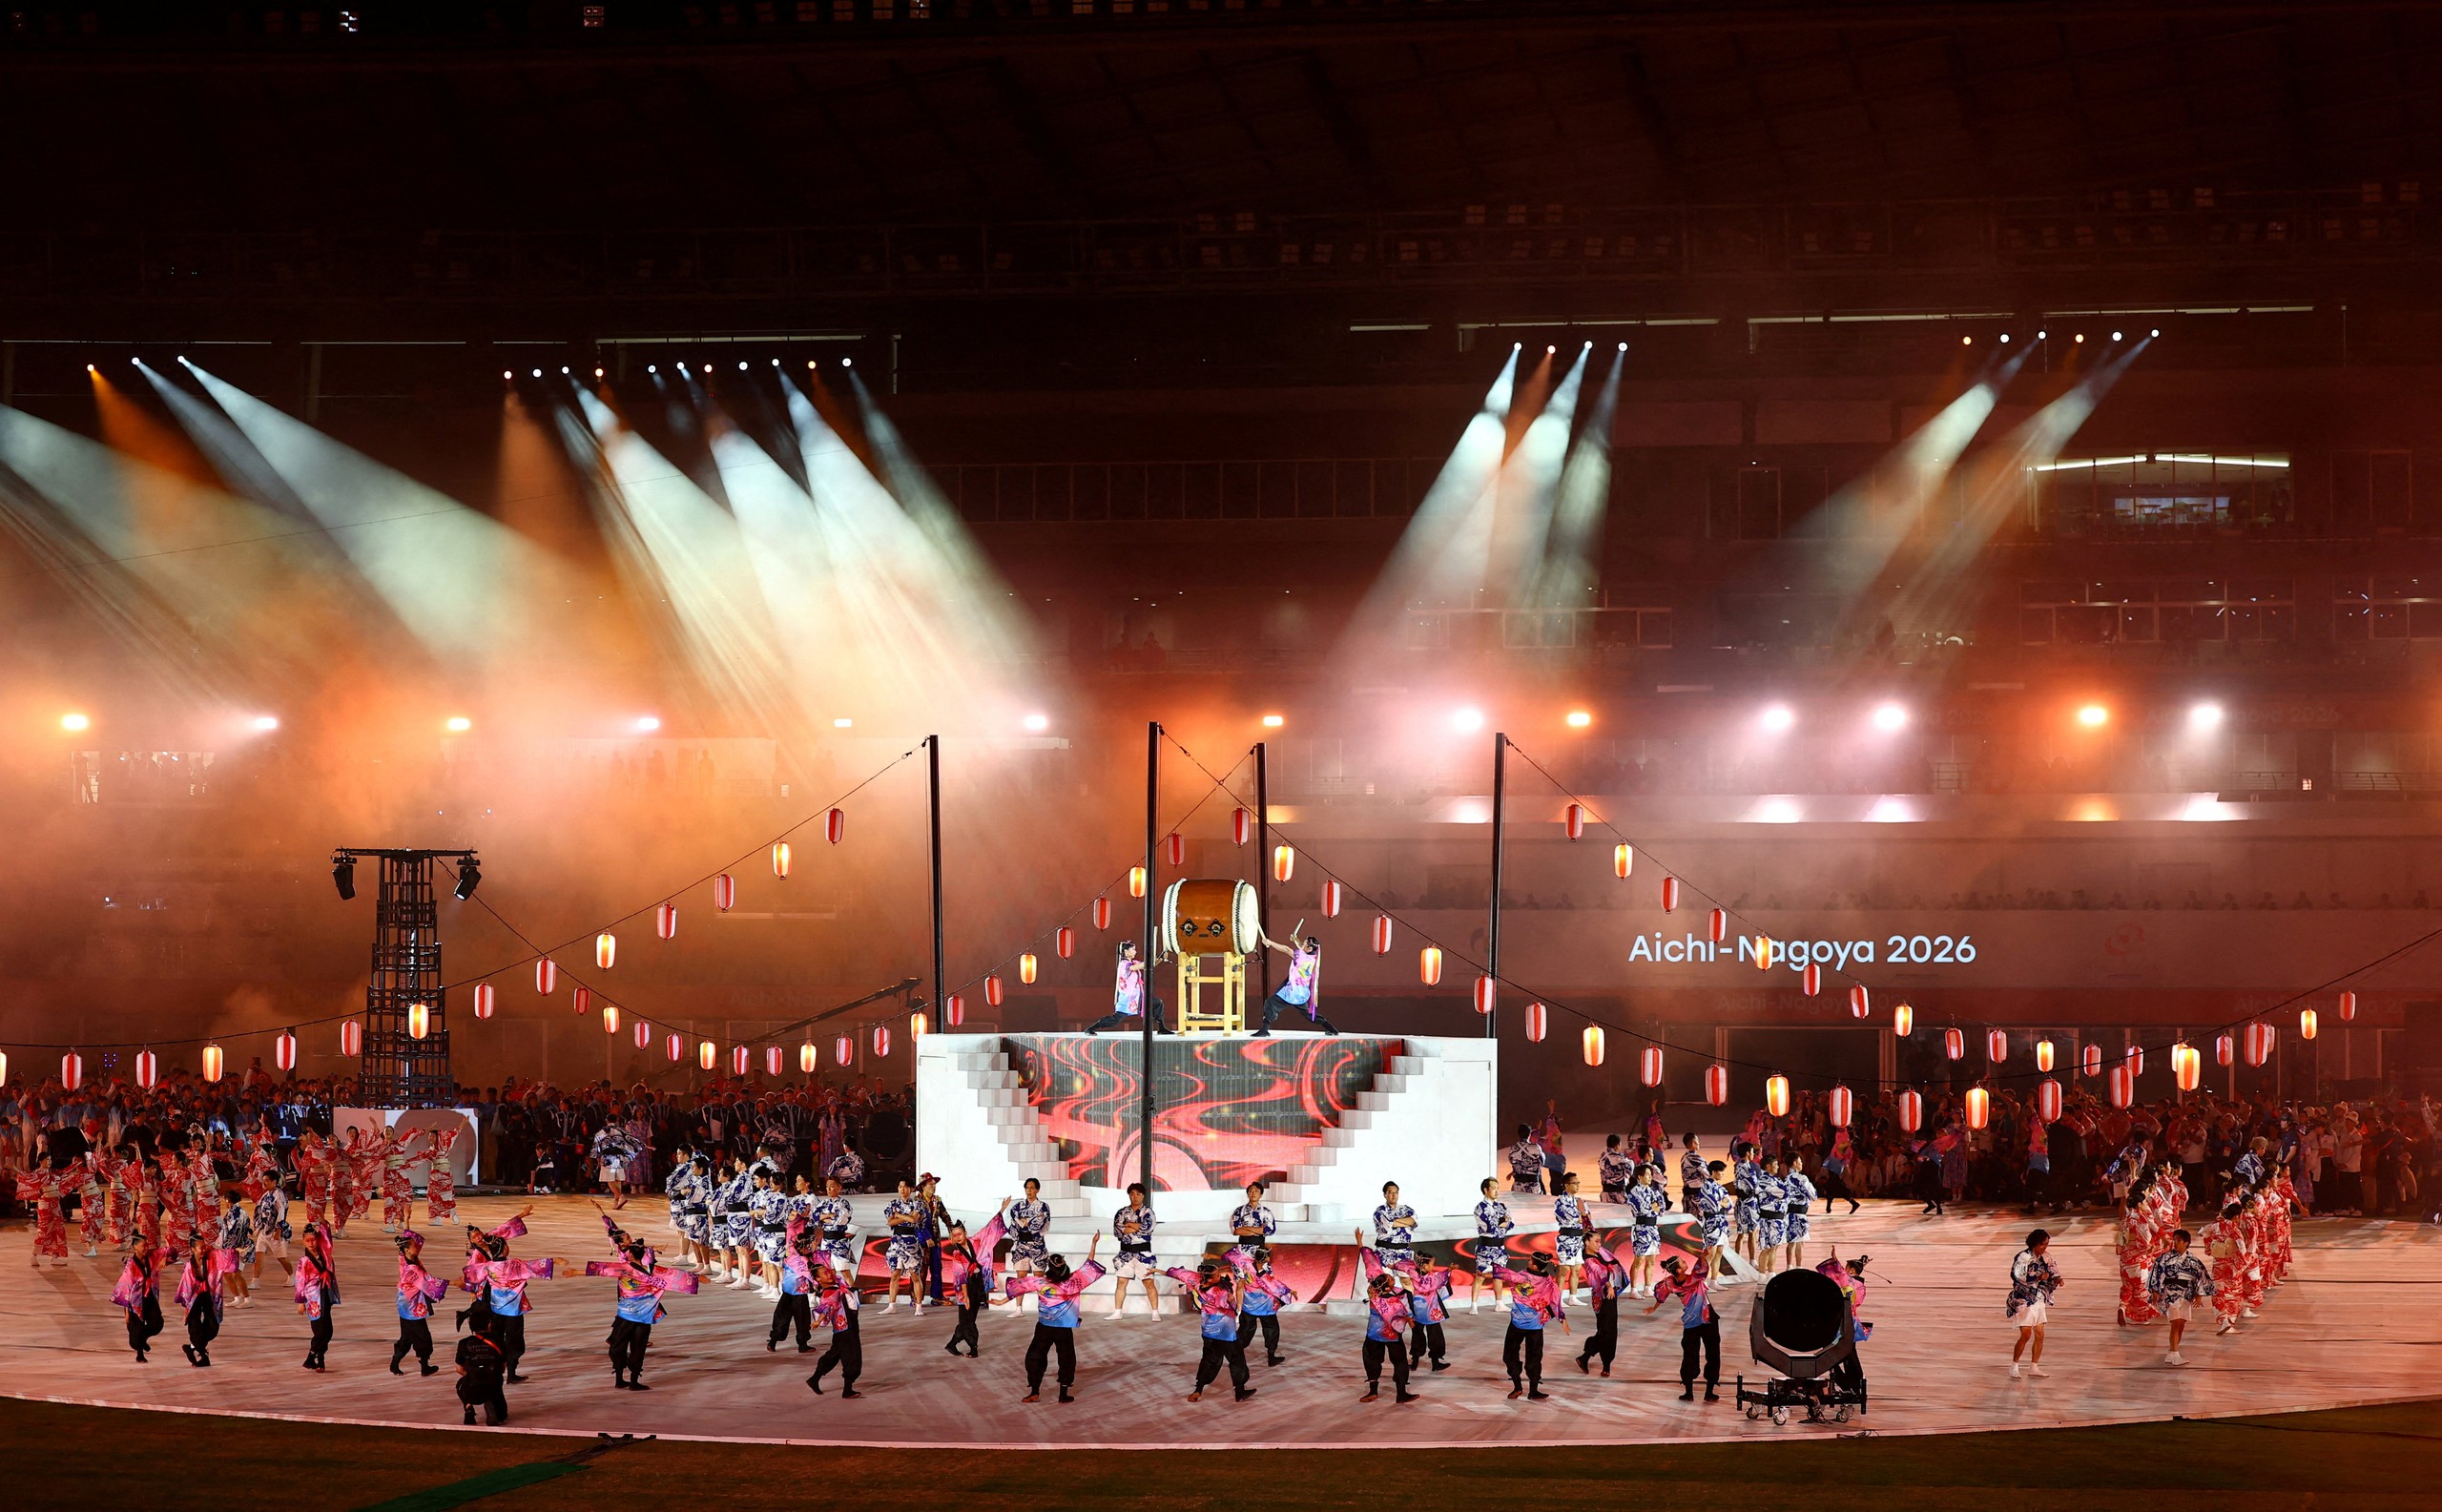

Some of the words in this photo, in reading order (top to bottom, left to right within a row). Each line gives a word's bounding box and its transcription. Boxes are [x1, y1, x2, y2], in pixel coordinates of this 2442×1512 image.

[1628, 931, 1874, 972] Aichi-Nagoya
[1887, 935, 1976, 963] 2026
[2234, 994, 2378, 1021] Aichi-agya
